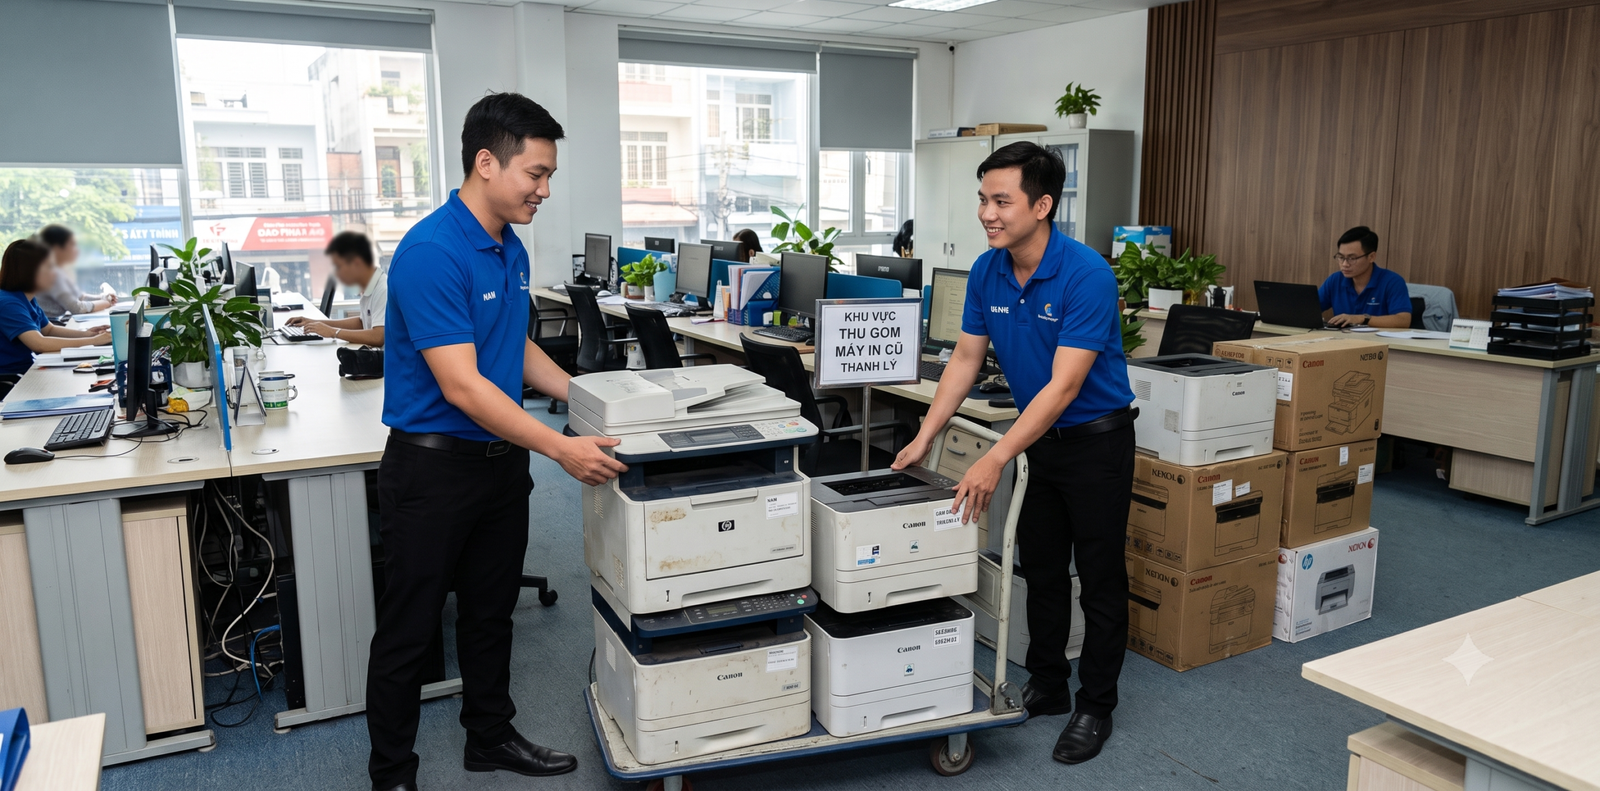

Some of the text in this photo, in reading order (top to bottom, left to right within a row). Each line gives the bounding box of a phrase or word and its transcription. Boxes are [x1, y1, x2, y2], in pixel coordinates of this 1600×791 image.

[482, 290, 496, 301] NAM
[844, 311, 896, 324] KHU VỰC
[839, 326, 901, 340] THU GOM
[835, 341, 903, 358] MÁY IN CŨ
[841, 358, 897, 373] THANH LÝ
[1302, 359, 1325, 369] Canon
[1197, 473, 1221, 484] Canon
[902, 521, 926, 529] Canon
[1190, 575, 1213, 586] Canon
[897, 645, 921, 653] Canon
[717, 672, 743, 681] Canon
